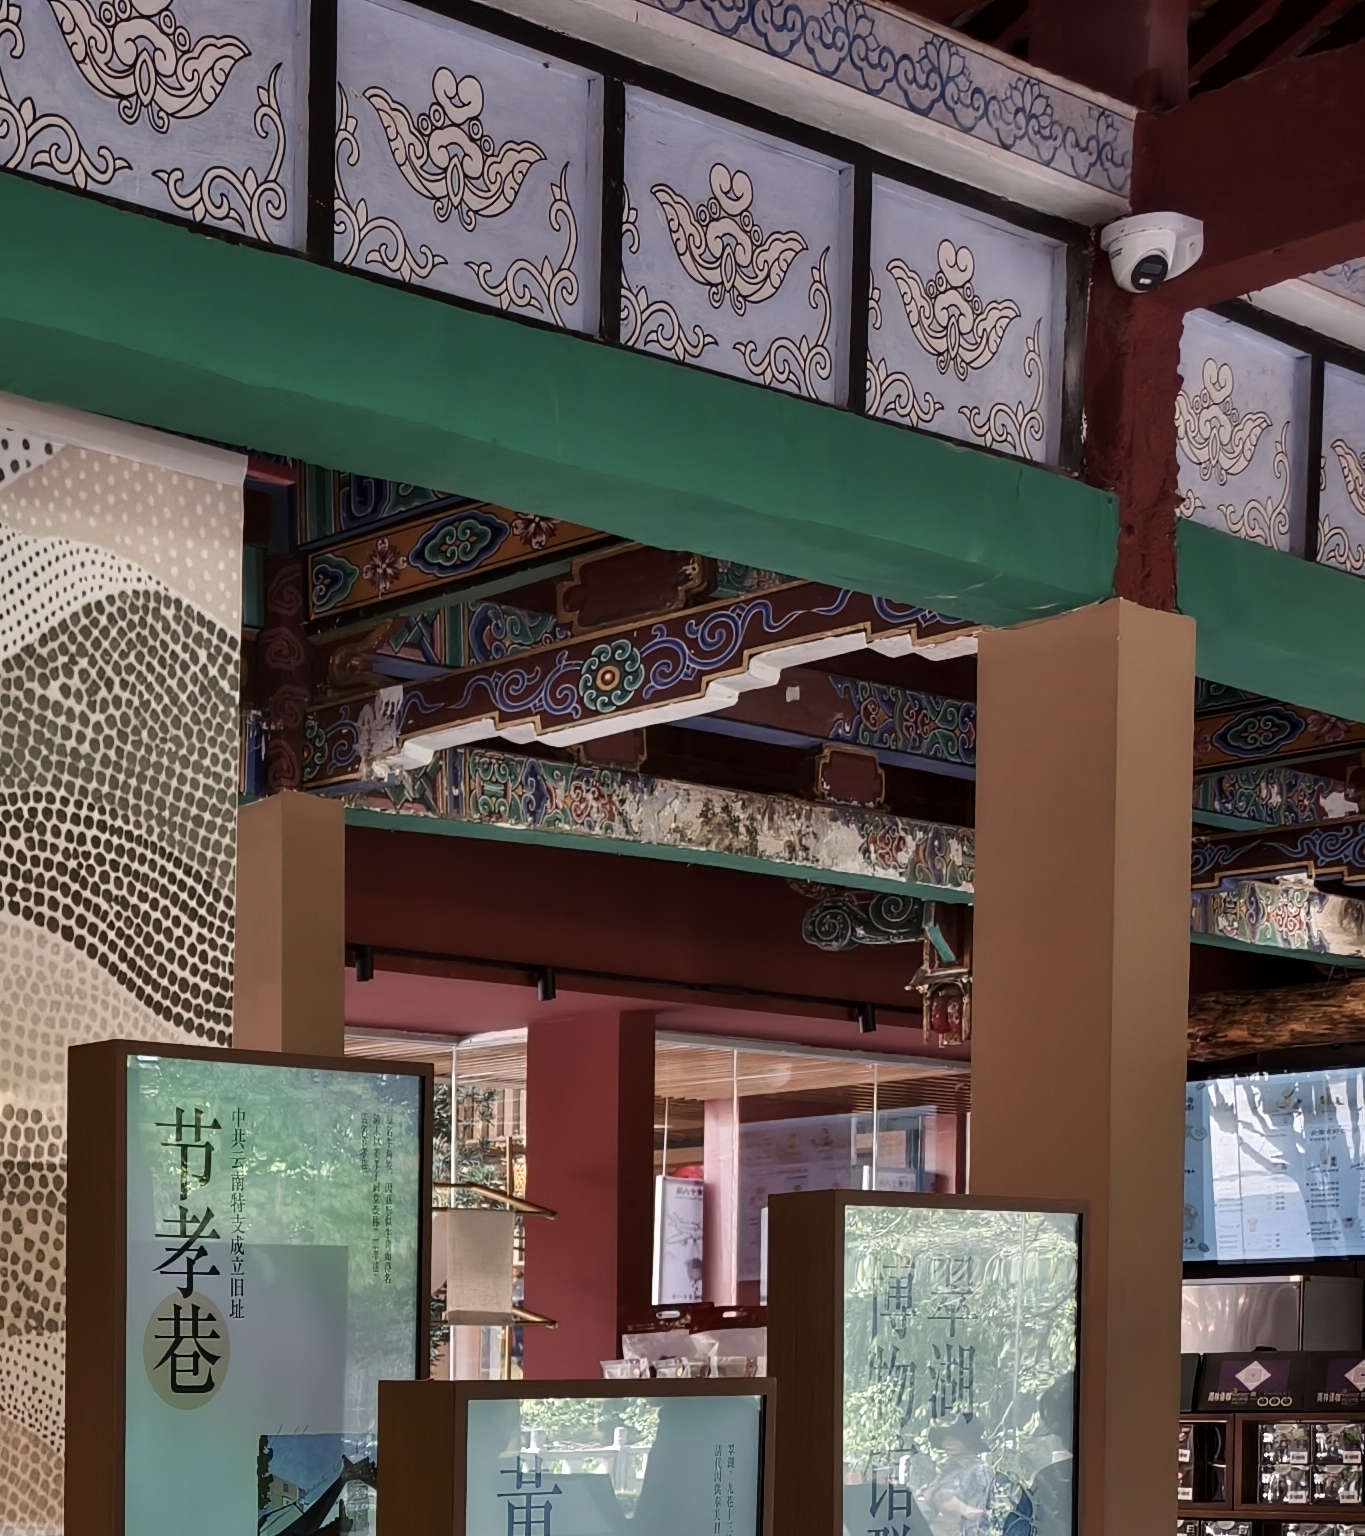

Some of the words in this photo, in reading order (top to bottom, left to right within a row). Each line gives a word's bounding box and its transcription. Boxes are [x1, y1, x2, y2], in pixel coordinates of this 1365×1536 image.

[152, 1107, 222, 1394] 节孝巷
[229, 1107, 247, 1319] 中共云南特支成立旧址
[927, 1255, 979, 1425] 翠湖
